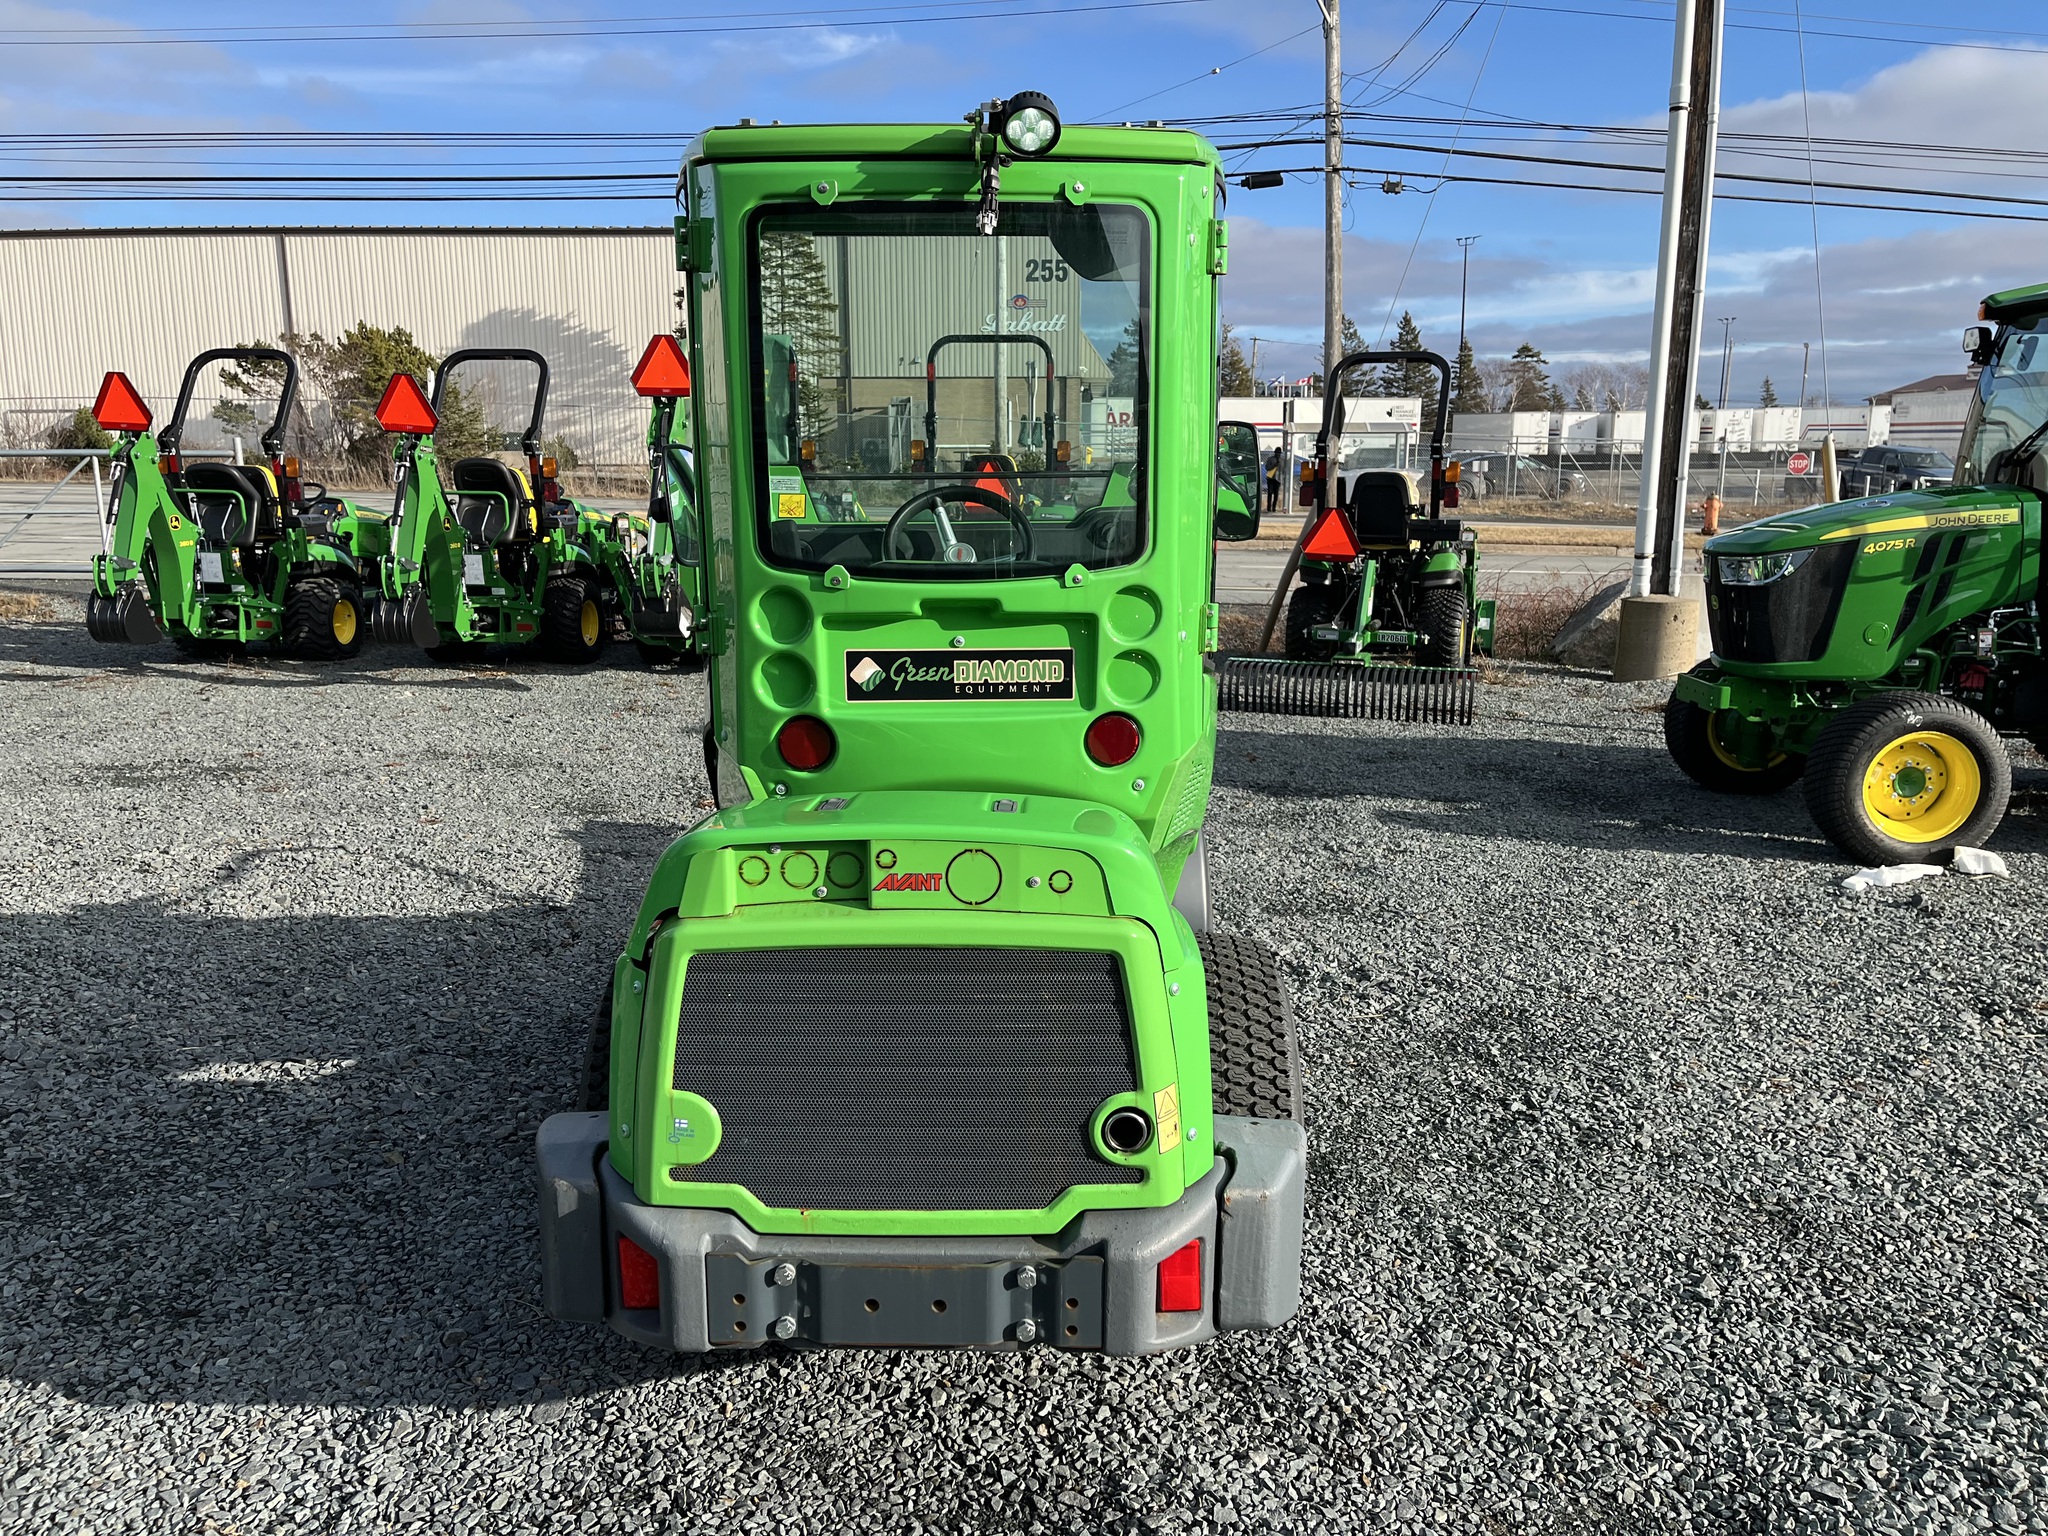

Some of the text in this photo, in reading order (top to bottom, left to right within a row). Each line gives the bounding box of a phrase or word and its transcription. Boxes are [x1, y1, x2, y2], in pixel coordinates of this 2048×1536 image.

[1025, 259, 1068, 282] 255
[1789, 459, 1808, 469] STOP
[1930, 513, 2010, 527] JOHN DEERE
[890, 656, 1064, 691] Green DIAMOND
[955, 684, 1052, 694] EQUIPMENT
[872, 873, 943, 891] AVANT
